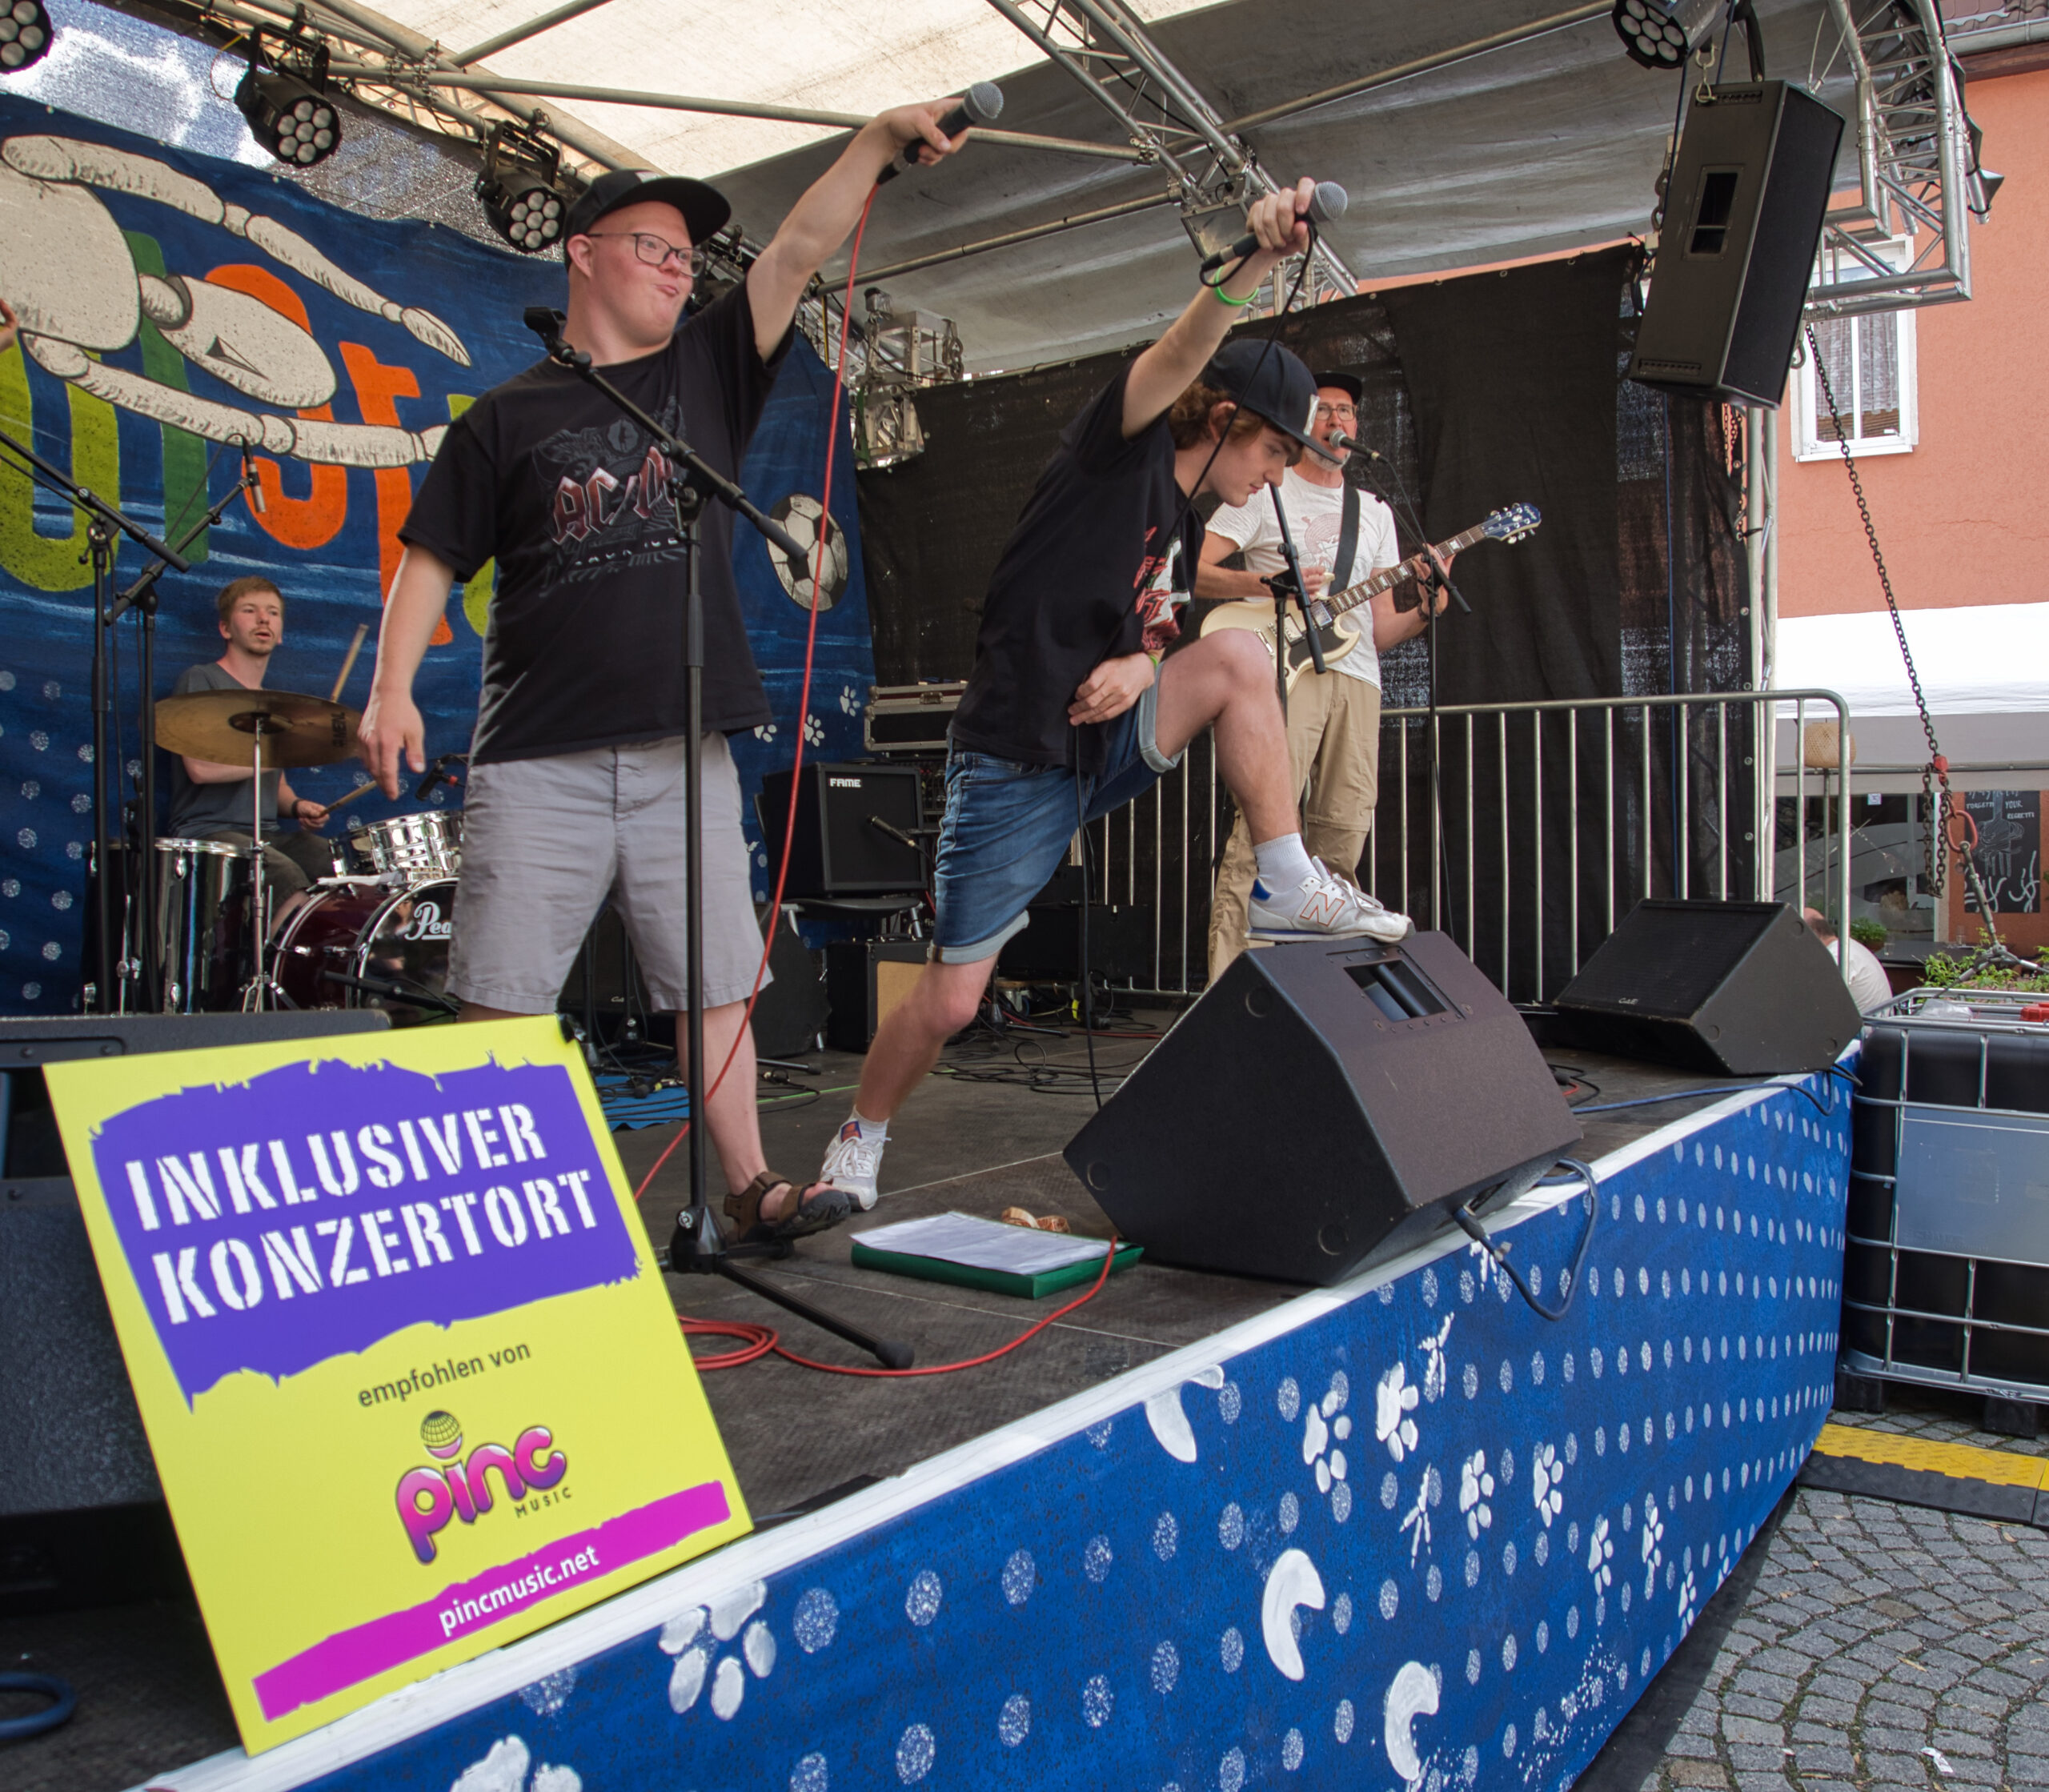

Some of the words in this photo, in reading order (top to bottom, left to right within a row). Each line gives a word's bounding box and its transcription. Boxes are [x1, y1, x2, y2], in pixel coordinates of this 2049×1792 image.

[829, 777, 862, 788] FAME
[2005, 800, 2023, 808] YOUR
[404, 901, 452, 940] Pea
[1299, 891, 1345, 927] N
[126, 1104, 547, 1231] INKLUSIVER
[152, 1169, 597, 1325] KONZERTORT
[358, 1354, 485, 1407] empfohlen
[488, 1343, 531, 1368] von
[395, 1409, 567, 1565] pinc
[514, 1486, 572, 1518] MUSIC
[439, 1545, 599, 1638] pincmusic.net
